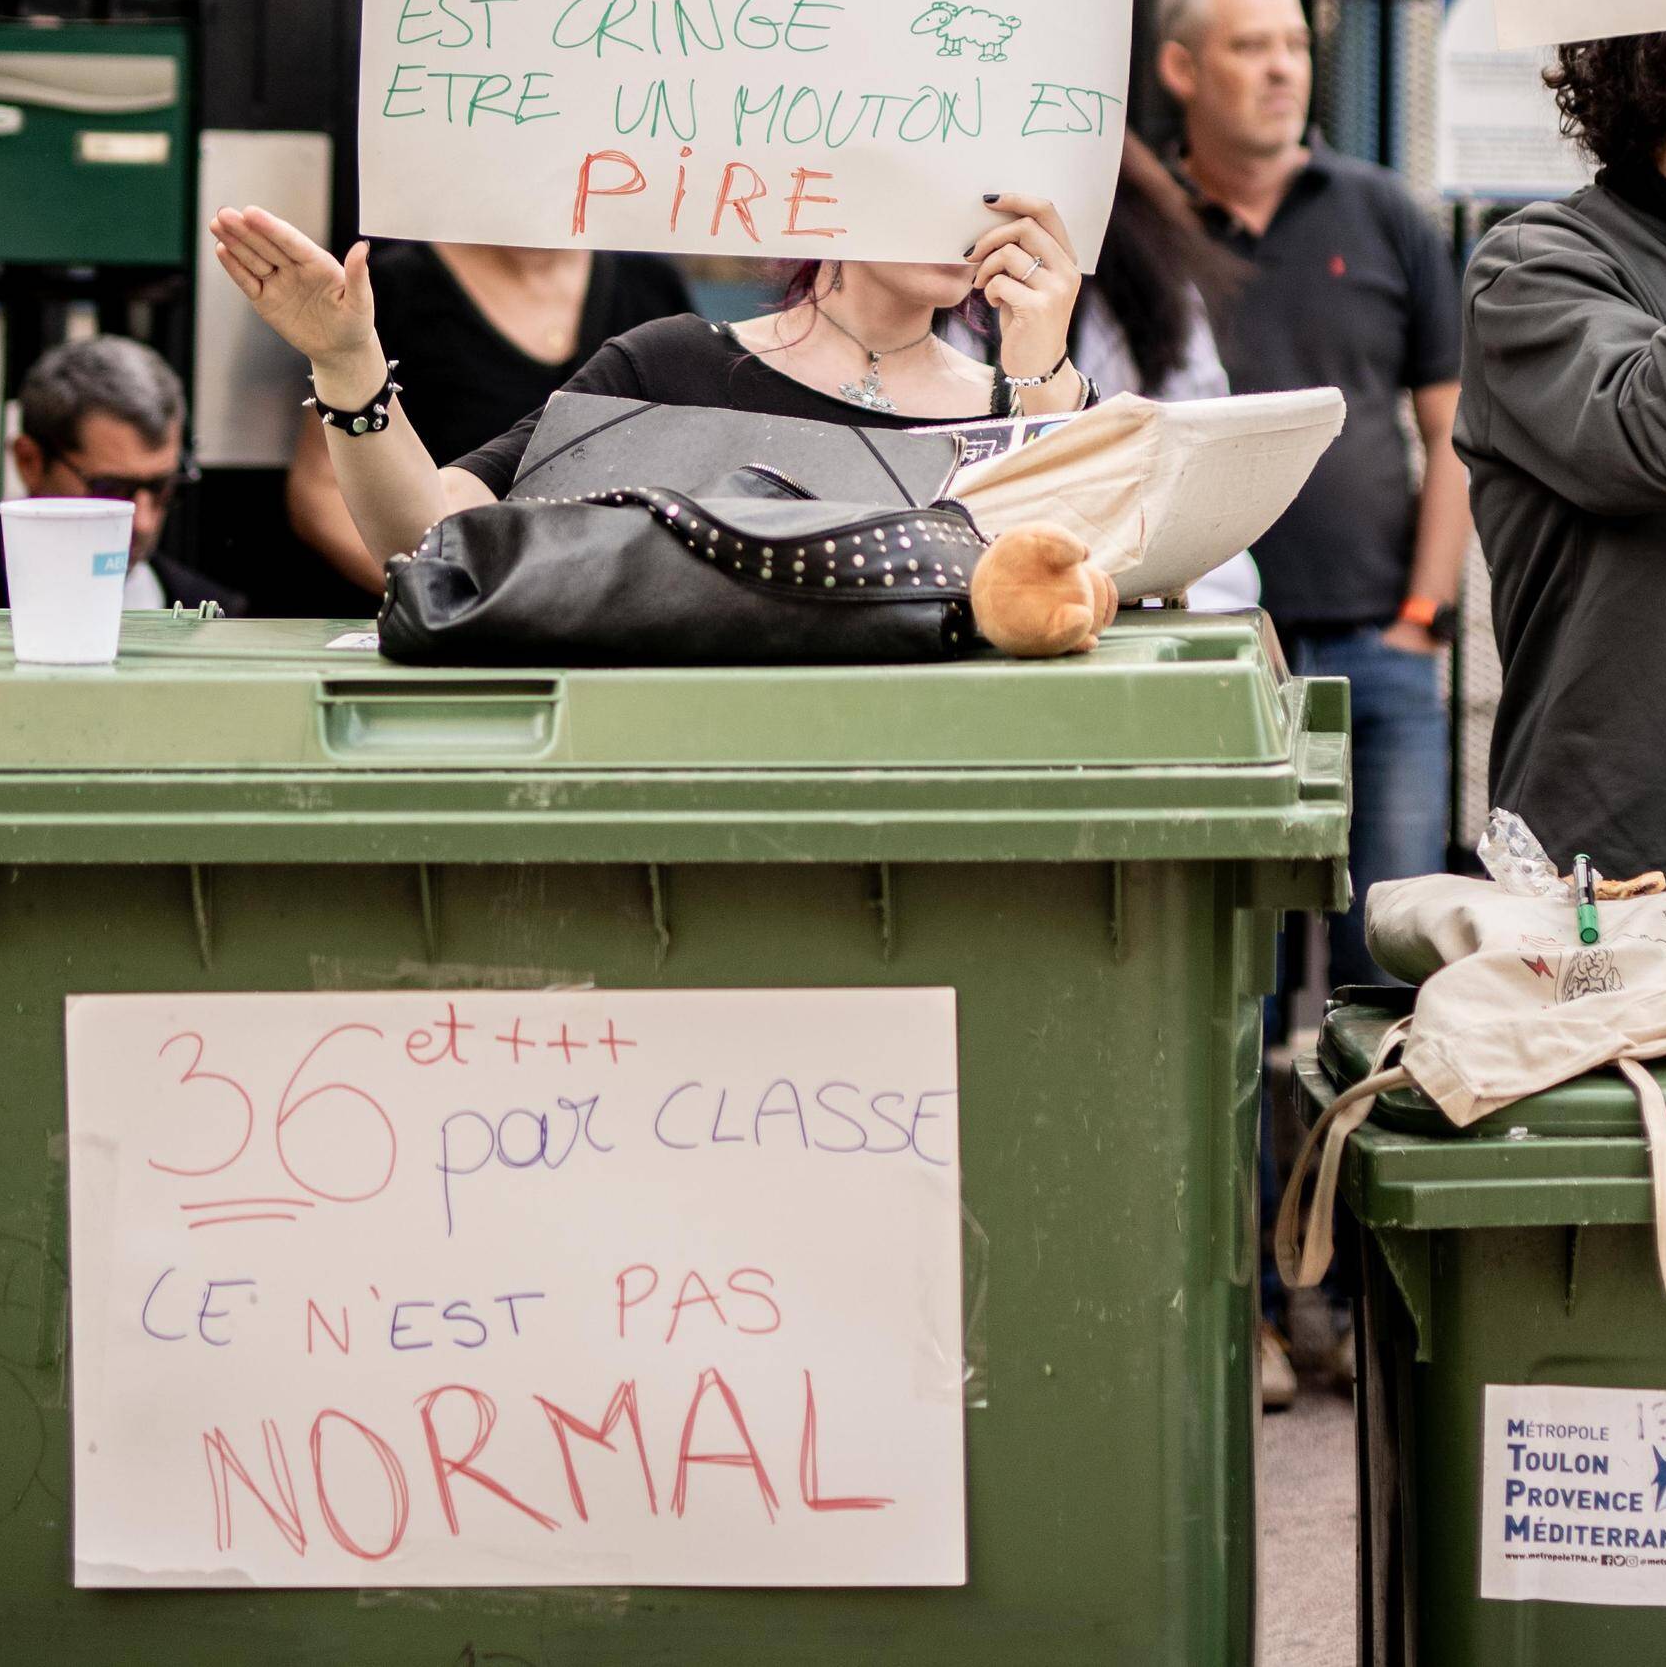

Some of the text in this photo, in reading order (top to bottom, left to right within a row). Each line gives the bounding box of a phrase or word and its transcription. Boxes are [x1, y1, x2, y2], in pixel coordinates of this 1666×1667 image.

[382, 64, 1123, 150] ETRE UN MOUTON EST
[404, 1002, 477, 1066] et
[147, 1022, 398, 1204] 36
[654, 1079, 960, 1166] CLASSE
[435, 1093, 617, 1237] par
[141, 1262, 783, 1355] CE N'EST PAS
[201, 1367, 897, 1562] NORMAL
[1506, 1418, 1610, 1442] MÉTROPOLE
[1507, 1443, 1610, 1475] TOULON
[1504, 1479, 1644, 1513] PROVENCE
